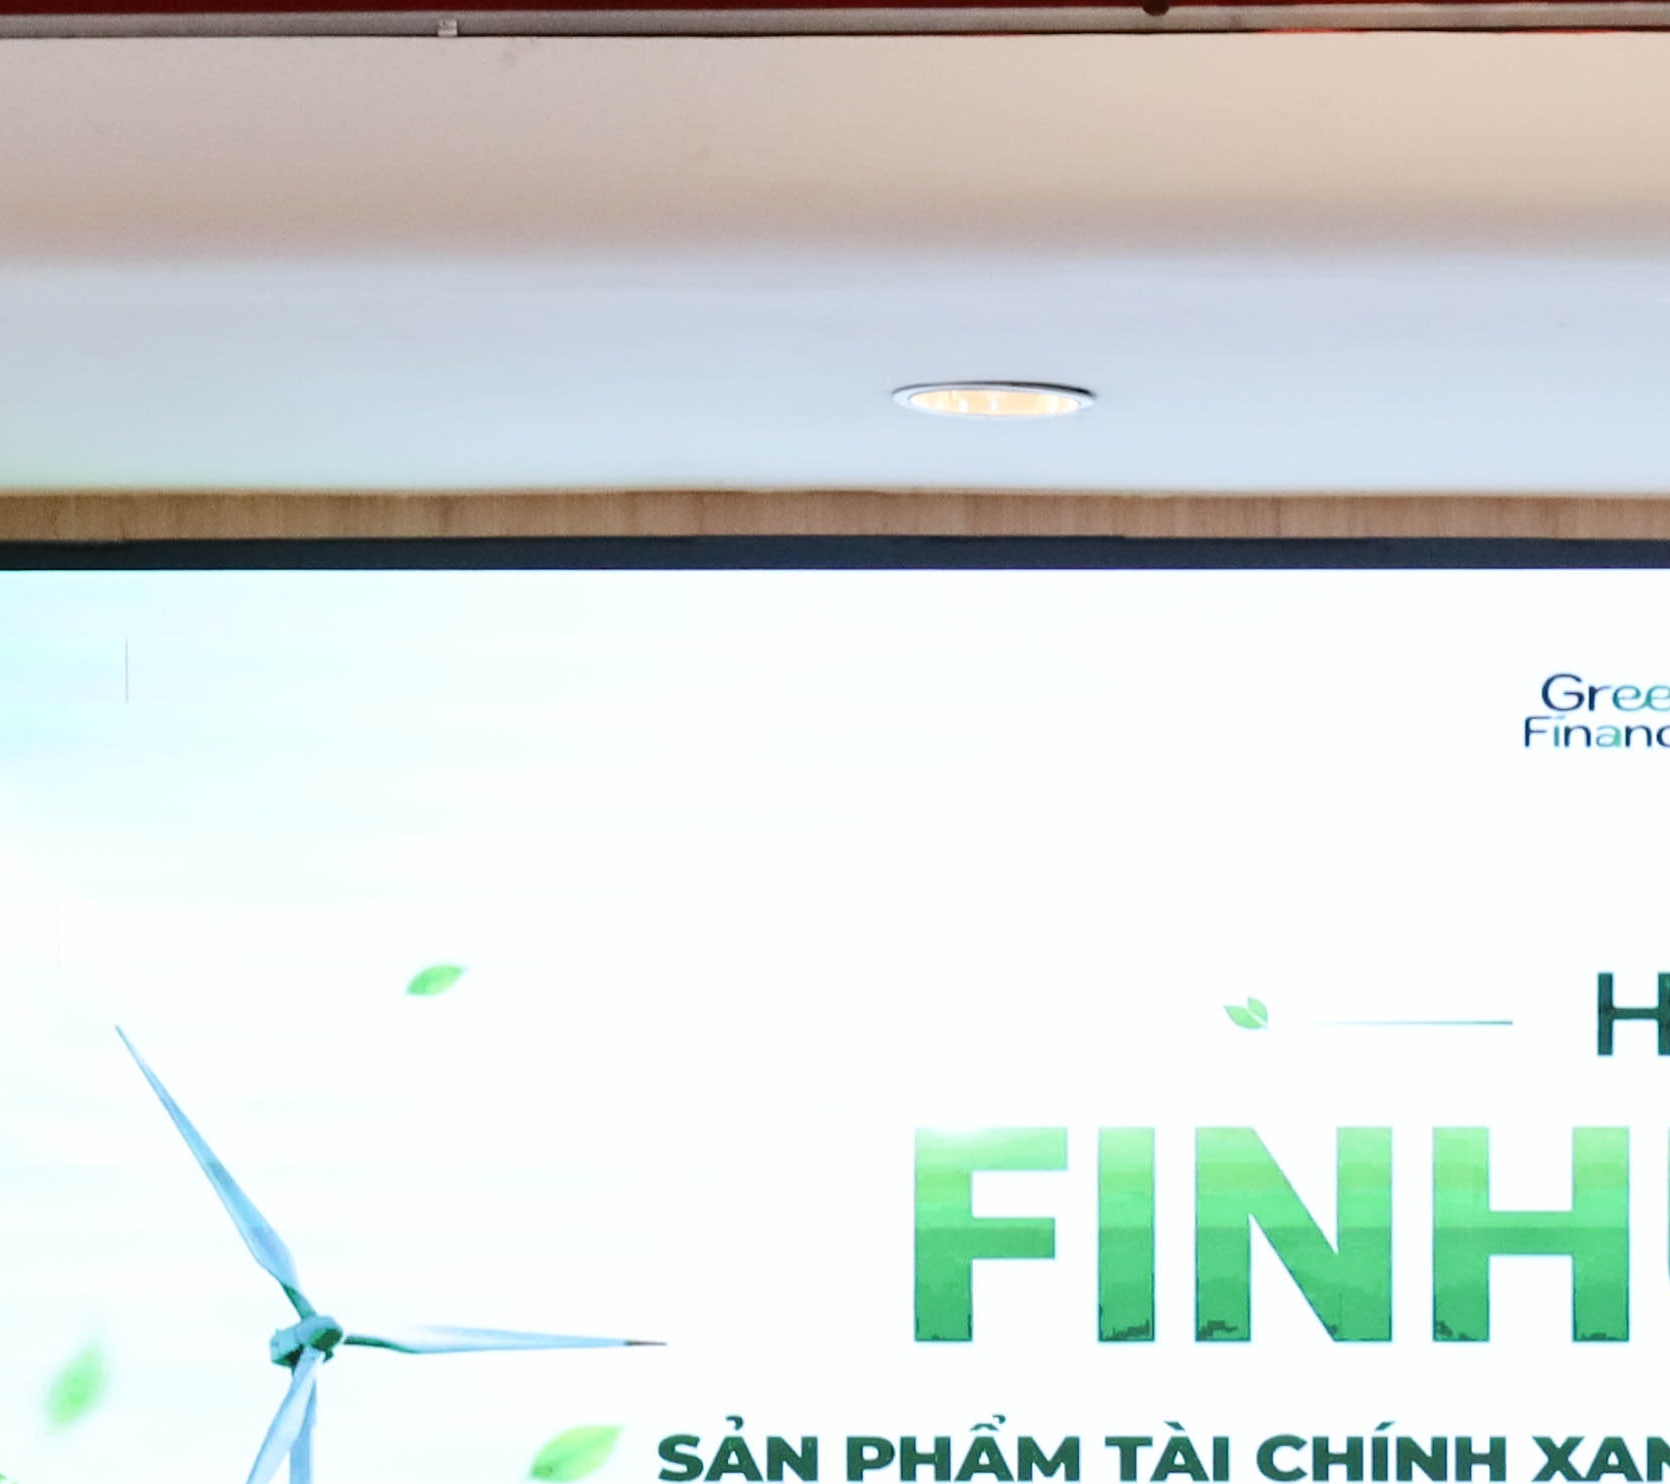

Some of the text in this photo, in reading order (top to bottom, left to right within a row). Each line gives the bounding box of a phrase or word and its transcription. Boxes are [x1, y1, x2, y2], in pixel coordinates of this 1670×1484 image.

[658, 1415, 818, 1482] SẢN
[846, 1414, 1080, 1482] PHẨM
[1104, 1421, 1230, 1482] TÀI
[1256, 1422, 1507, 1482] CHÍNH
